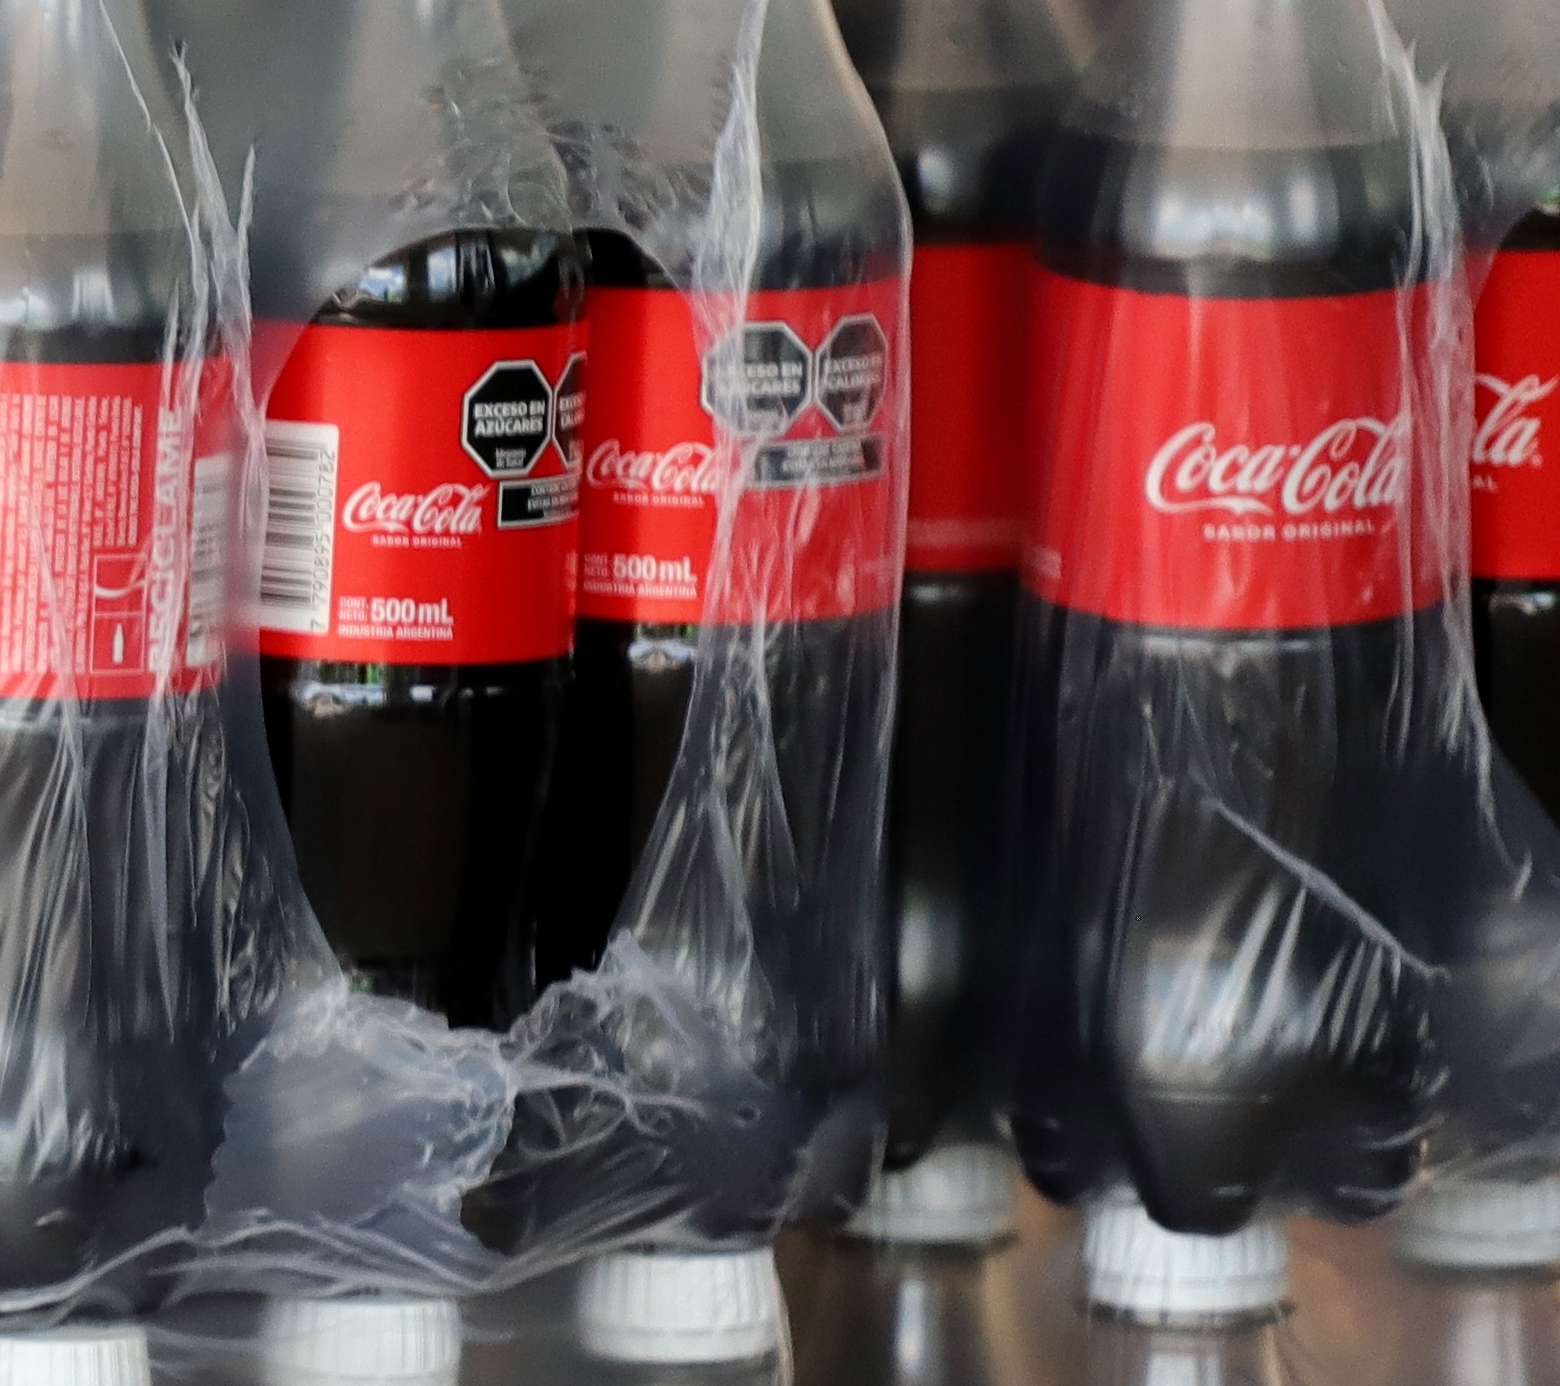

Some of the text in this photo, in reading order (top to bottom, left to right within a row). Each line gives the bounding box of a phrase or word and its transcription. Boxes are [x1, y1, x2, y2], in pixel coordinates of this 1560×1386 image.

[474, 402, 528, 418] EXCESO
[1146, 416, 1413, 515] Coca-Cola
[342, 480, 492, 536] Coca-Cola
[1283, 519, 1376, 541] ORIGINAL
[372, 535, 462, 548] SABOR ORIGINAL
[338, 625, 453, 640] INDUSTRIA ARGENTINA
